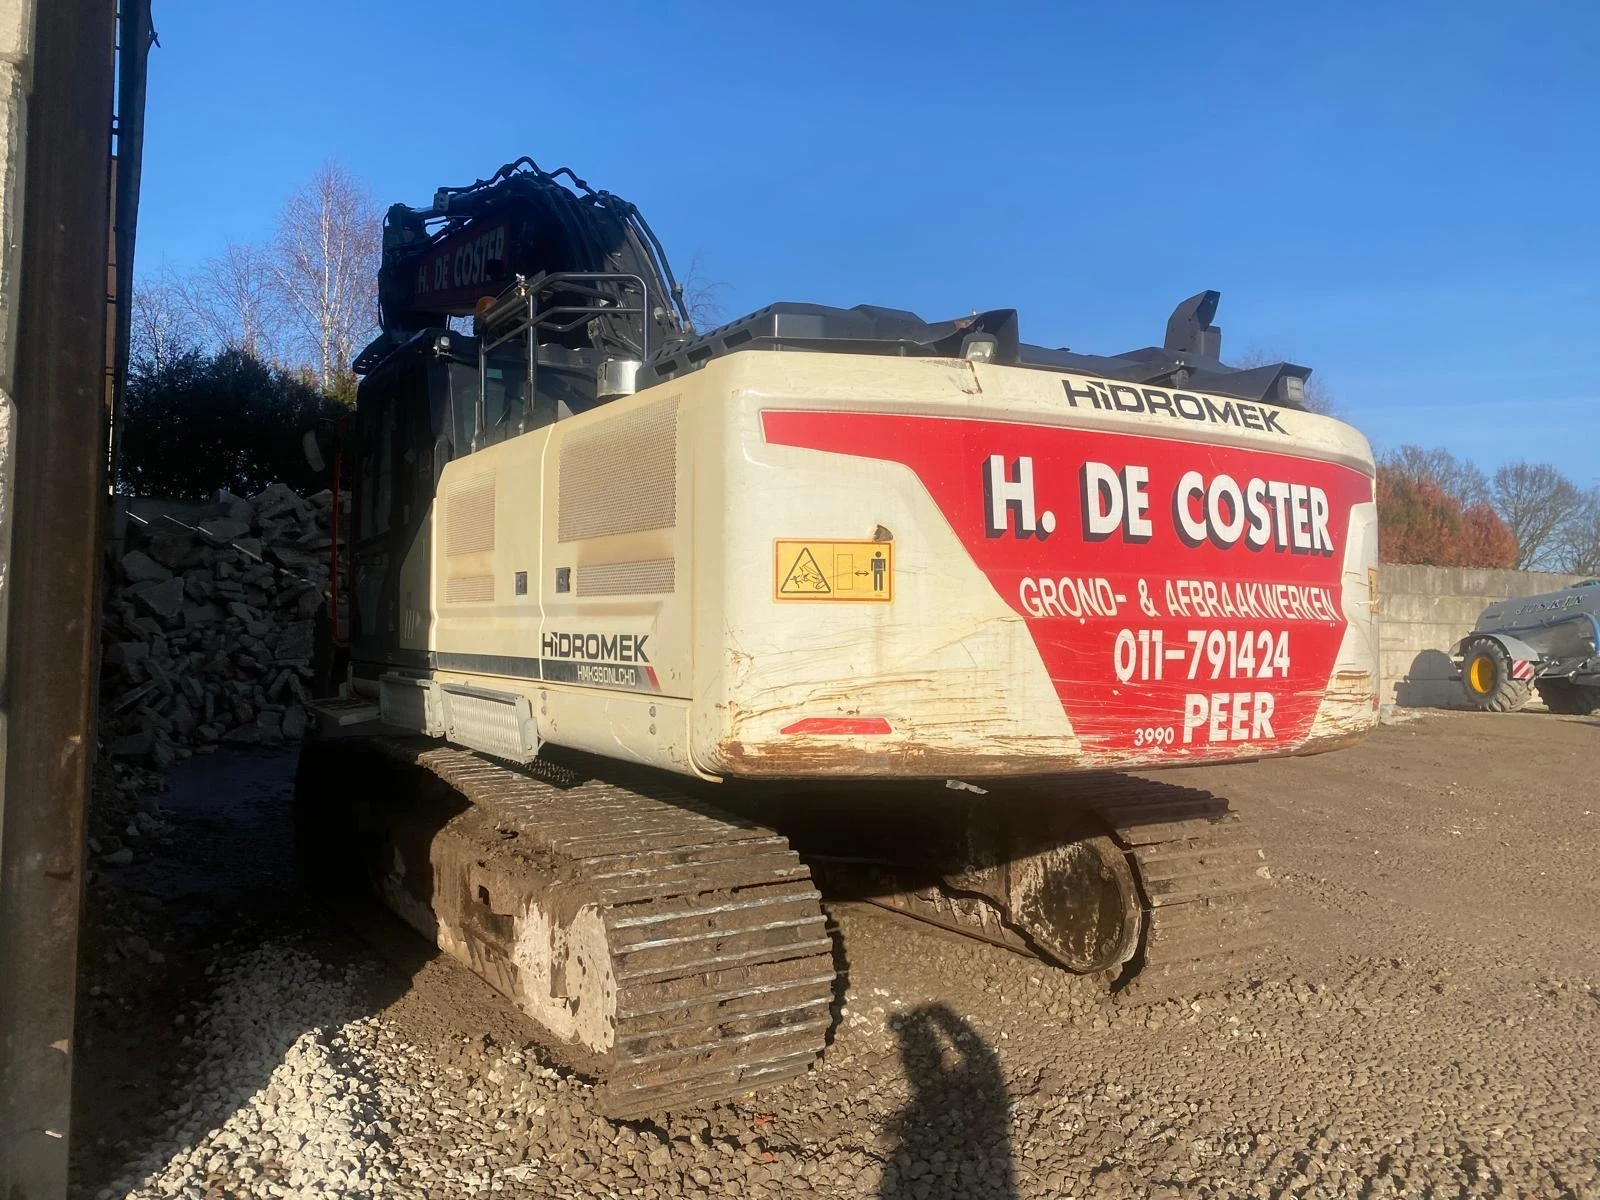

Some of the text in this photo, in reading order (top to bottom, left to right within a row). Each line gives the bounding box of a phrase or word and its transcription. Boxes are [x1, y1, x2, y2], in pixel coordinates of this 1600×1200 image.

[434, 254, 450, 291] DE
[983, 454, 1334, 553] H. DE COSTER
[1019, 577, 1343, 622] GROND- & AFBRAAKWERKEN
[1114, 628, 1291, 682] 011-791424
[1134, 691, 1276, 746] 3990 PEER
